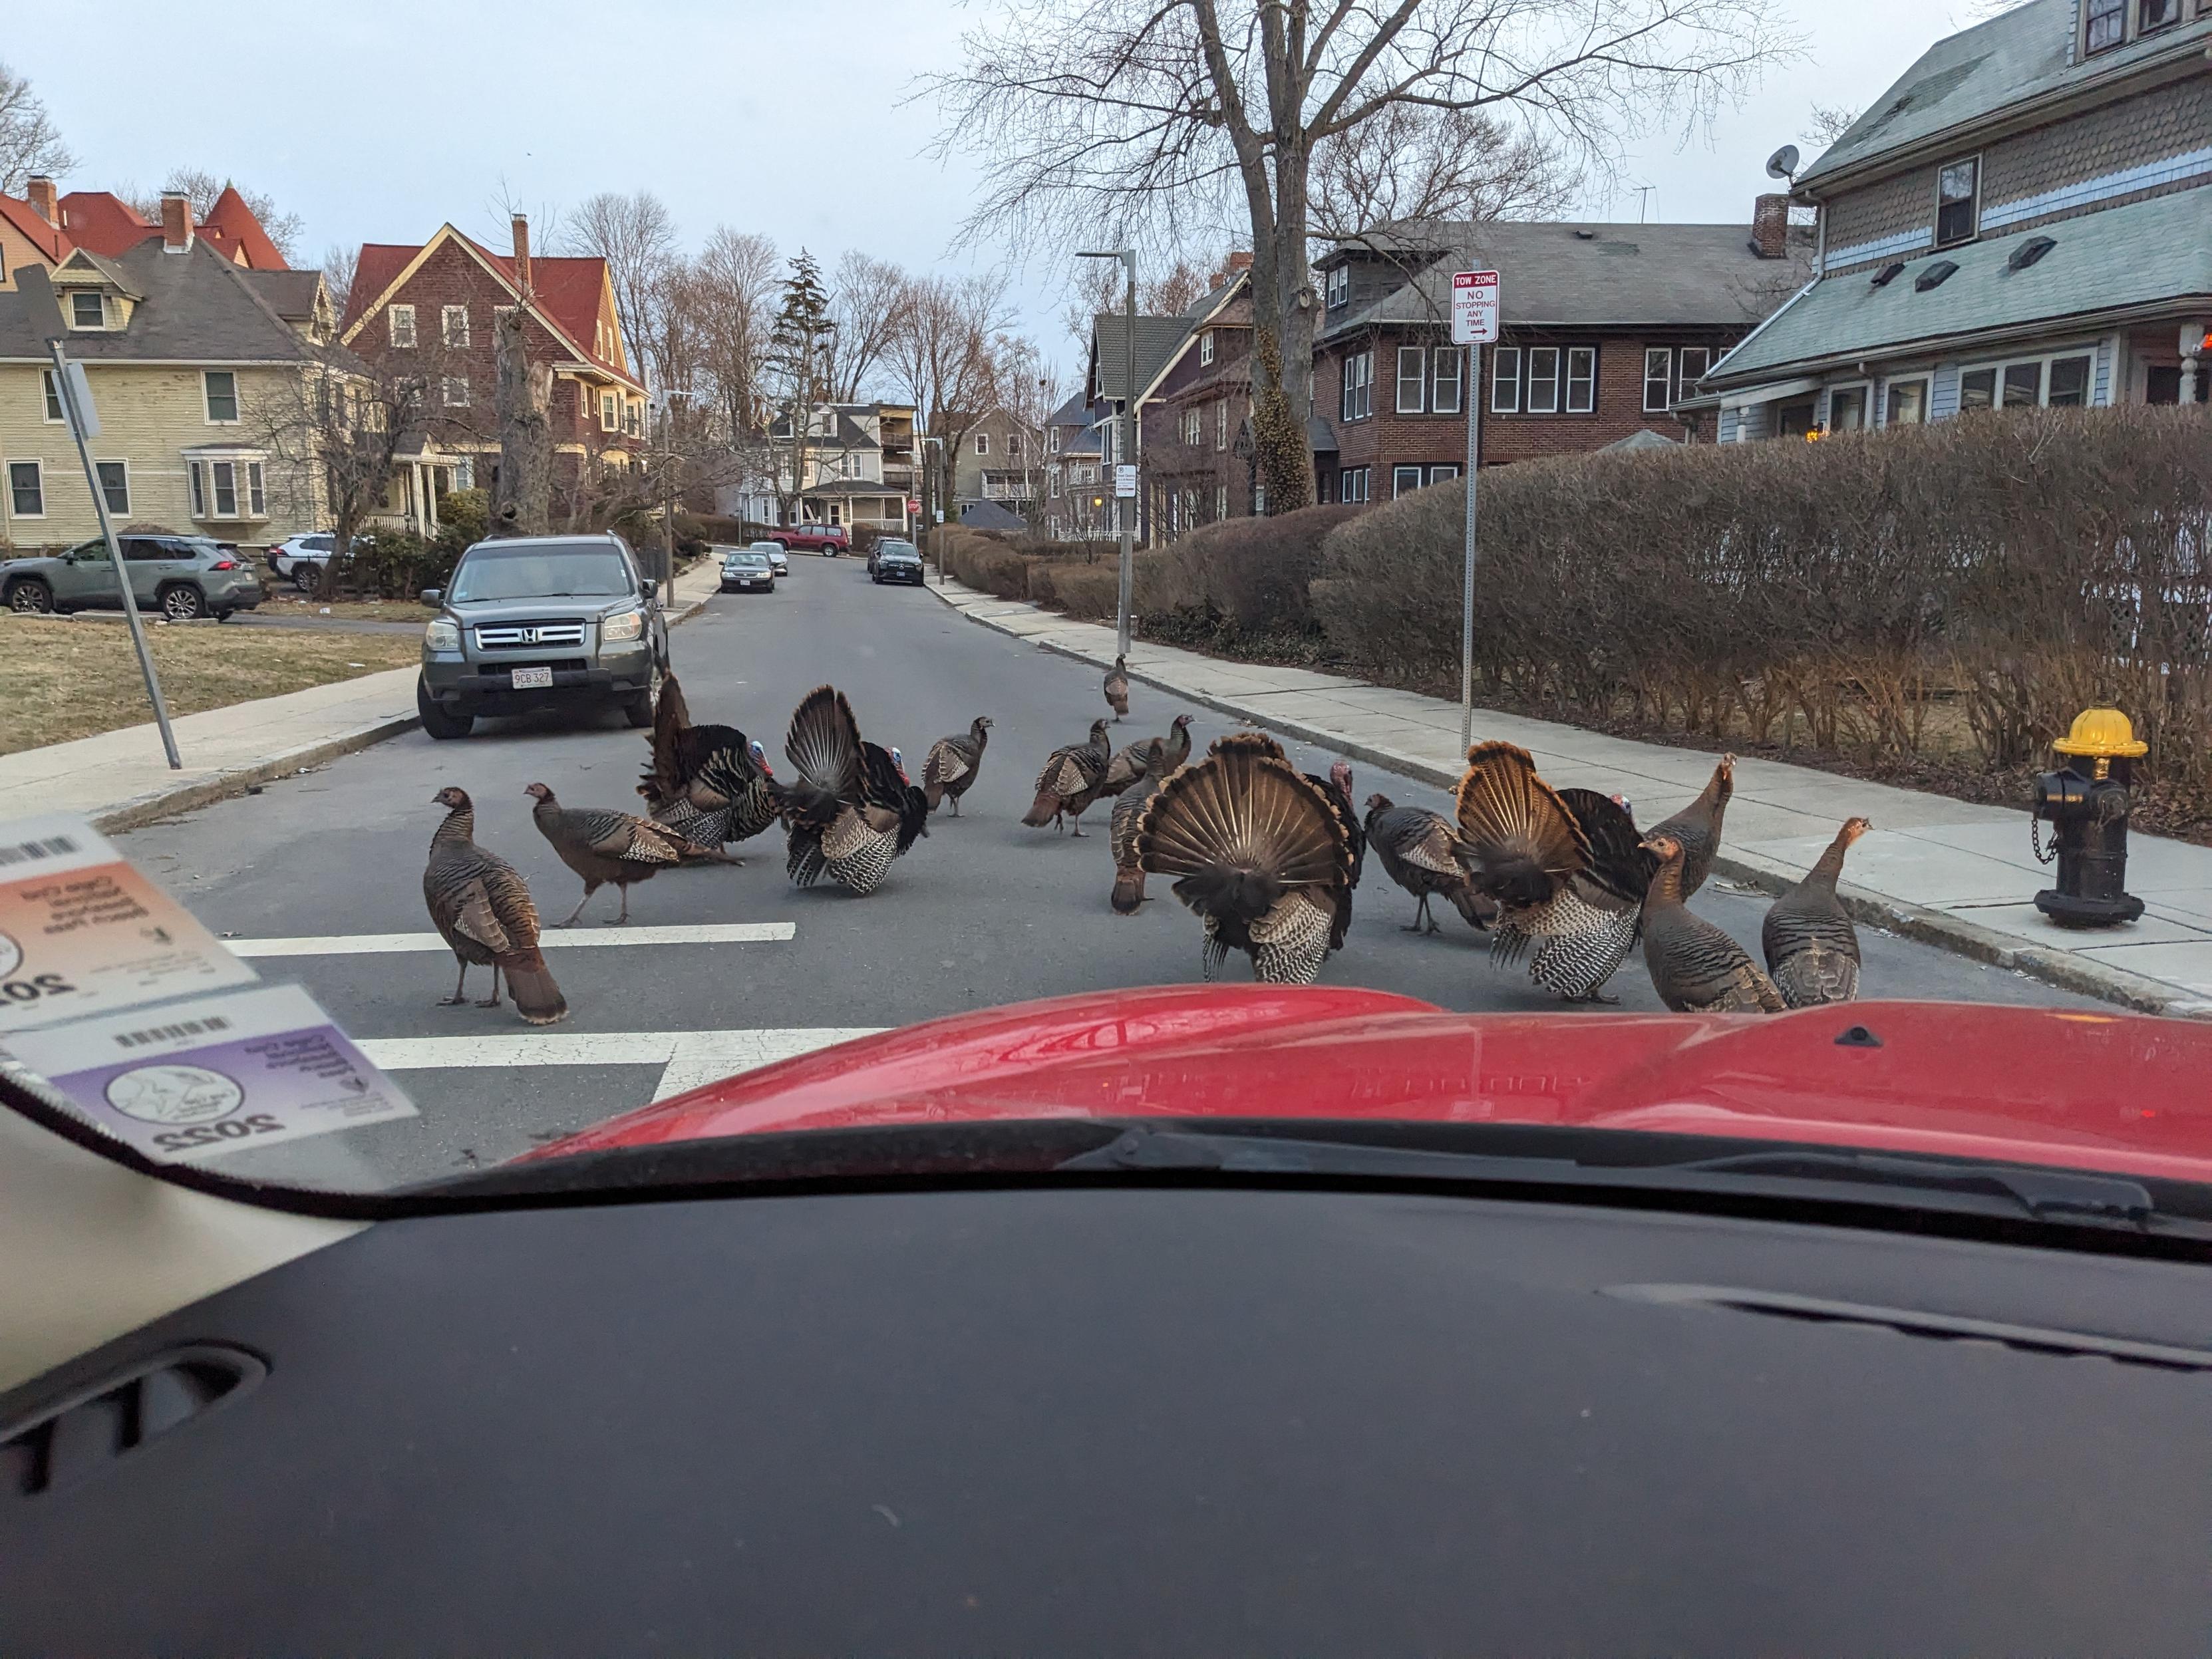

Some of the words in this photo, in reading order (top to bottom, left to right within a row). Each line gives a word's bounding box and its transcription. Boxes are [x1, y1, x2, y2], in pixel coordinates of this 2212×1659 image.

[1456, 277, 1472, 286] TOW
[1474, 275, 1496, 284] ZONE
[1467, 291, 1484, 300] NO
[1456, 300, 1496, 310] STOPPING
[515, 674, 532, 684] 9CB
[533, 673, 549, 682] 327
